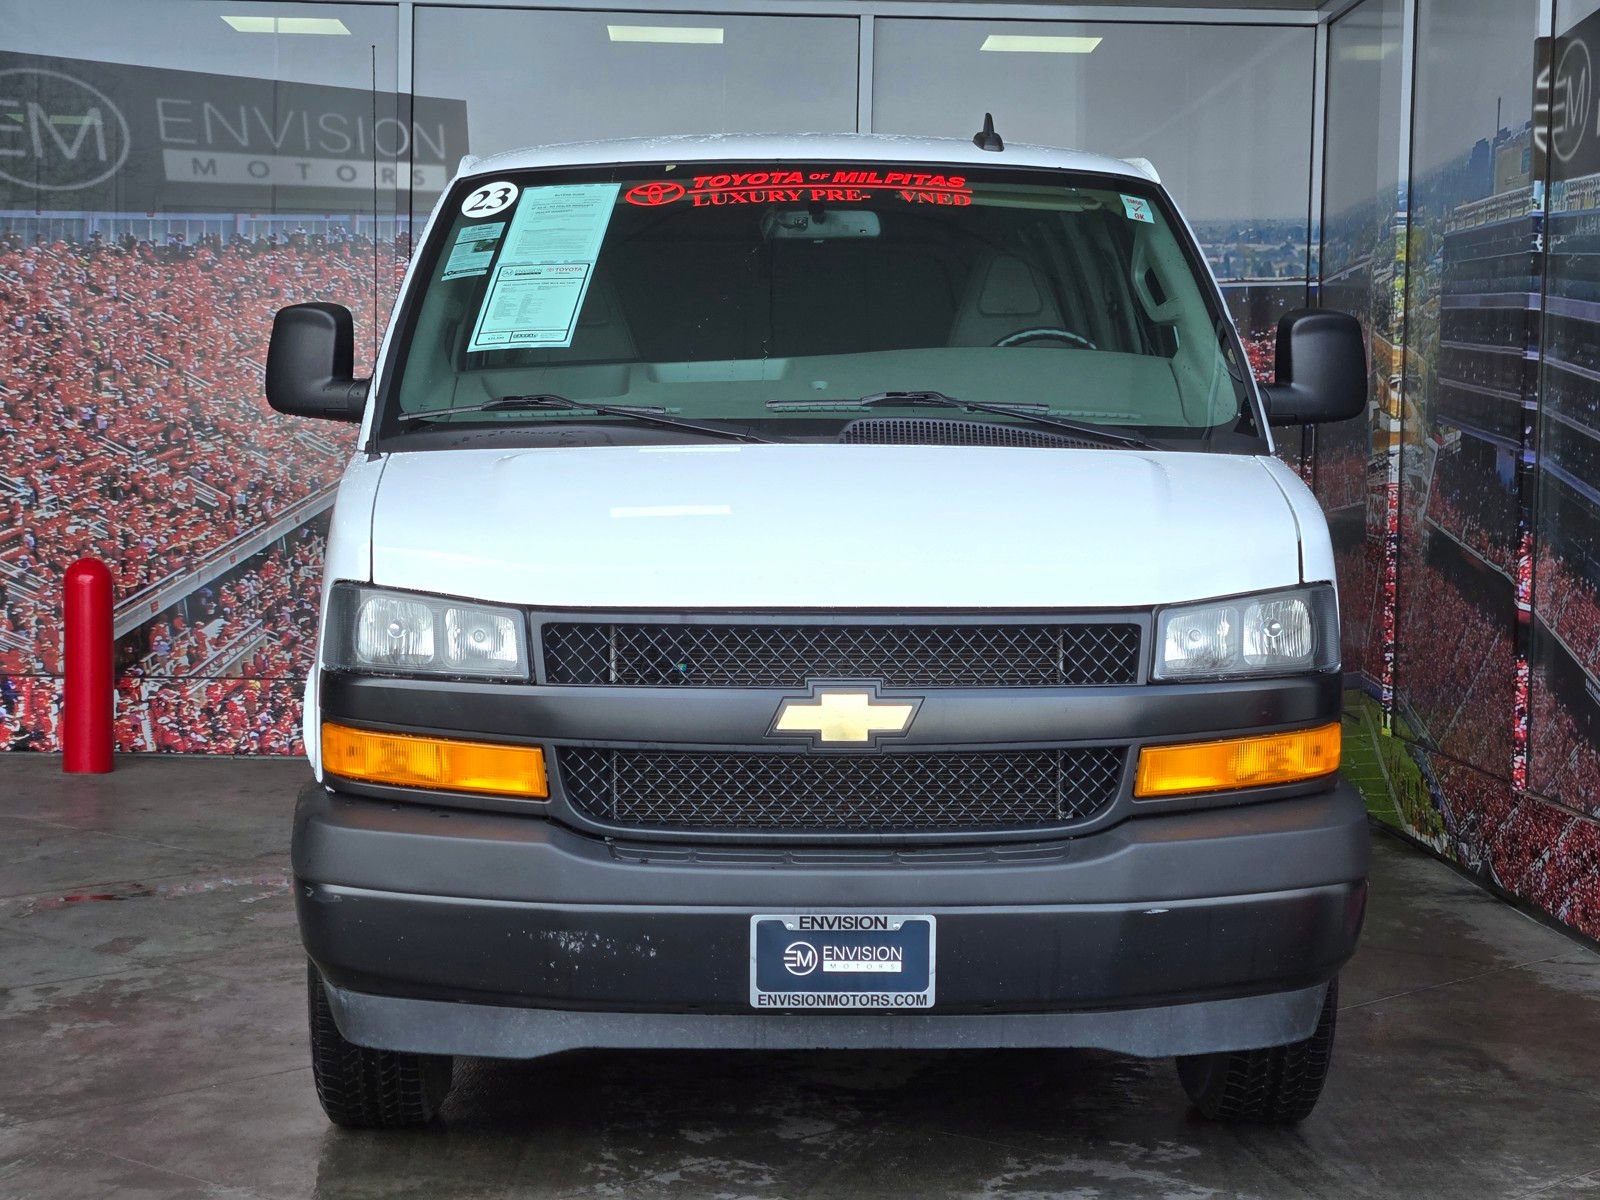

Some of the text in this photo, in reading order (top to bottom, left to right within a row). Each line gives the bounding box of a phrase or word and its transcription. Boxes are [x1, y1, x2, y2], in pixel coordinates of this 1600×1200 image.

[156, 98, 446, 160] ENVISION
[191, 157, 426, 186] MOTORS
[693, 171, 966, 189] TOYOTA OF MILPITAS
[465, 186, 512, 213] 23
[693, 189, 803, 207] LUXURY
[799, 916, 888, 930] ENVISION
[823, 946, 903, 961] ENVISION
[757, 994, 928, 1006] ENVISIONMOTORS.COM
